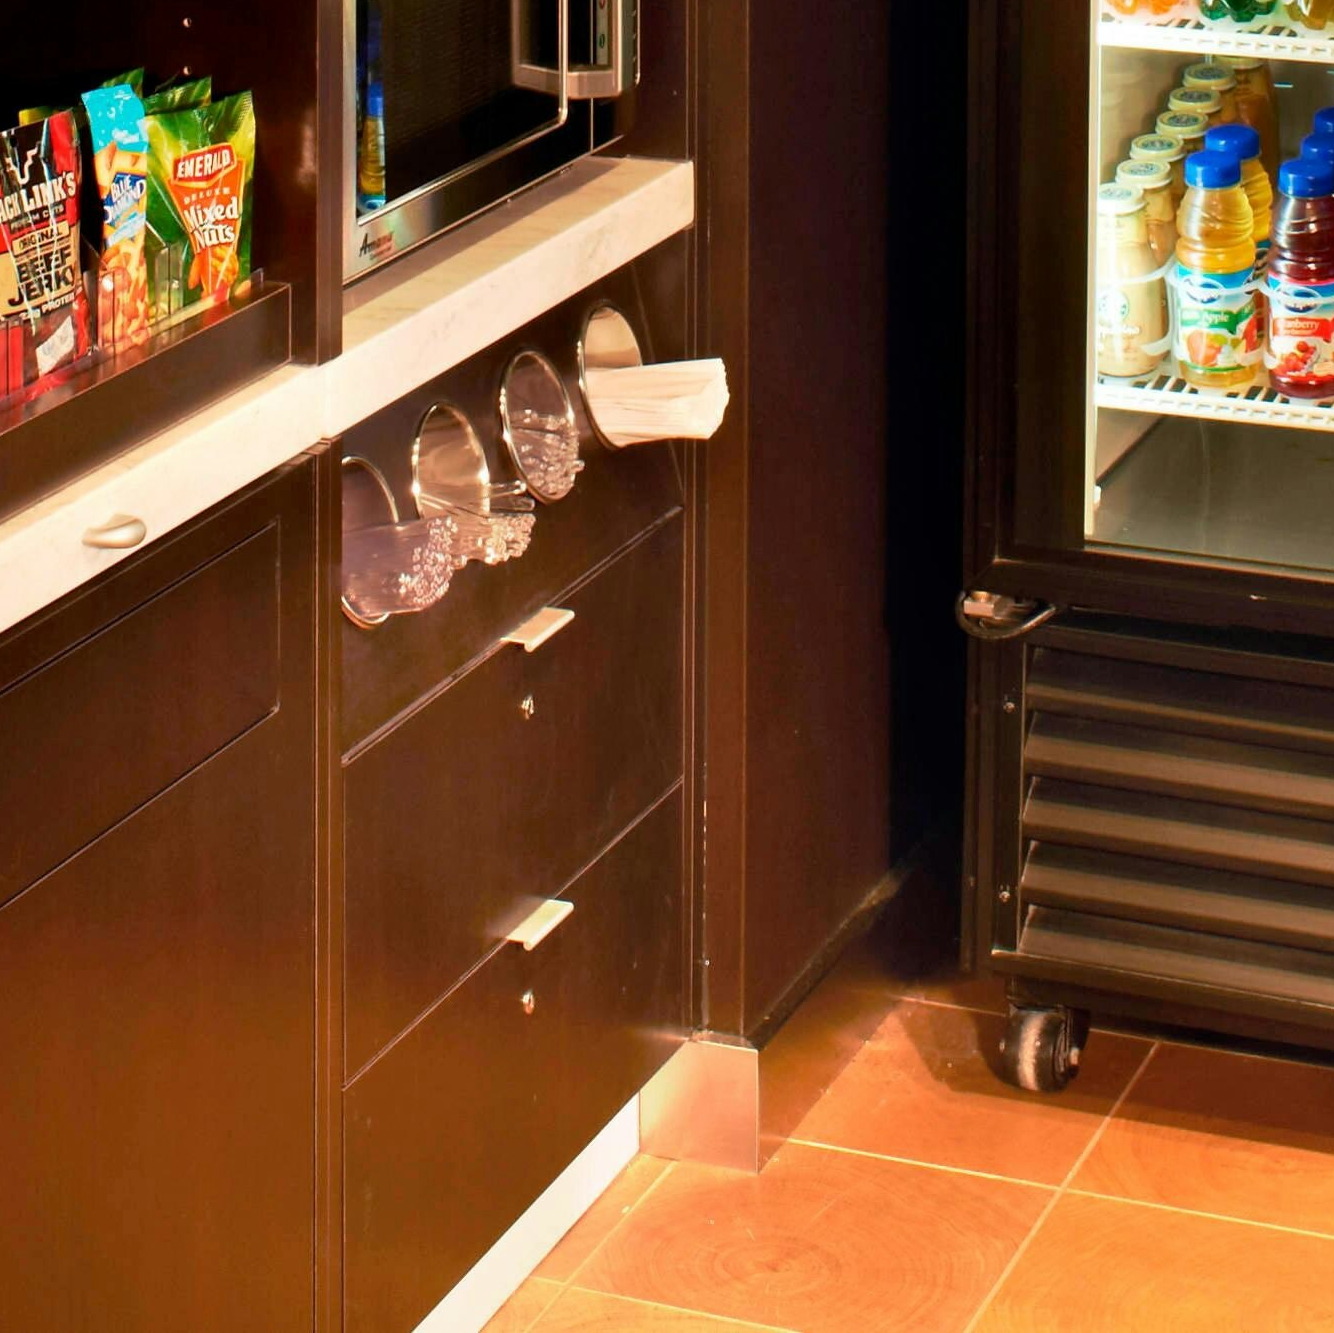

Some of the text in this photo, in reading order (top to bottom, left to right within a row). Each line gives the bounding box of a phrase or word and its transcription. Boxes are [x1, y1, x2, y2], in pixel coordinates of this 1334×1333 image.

[177, 149, 231, 179] EMERALD
[22, 170, 76, 212] LINK'S
[183, 196, 240, 229] Mixed
[193, 223, 236, 254] Nuts
